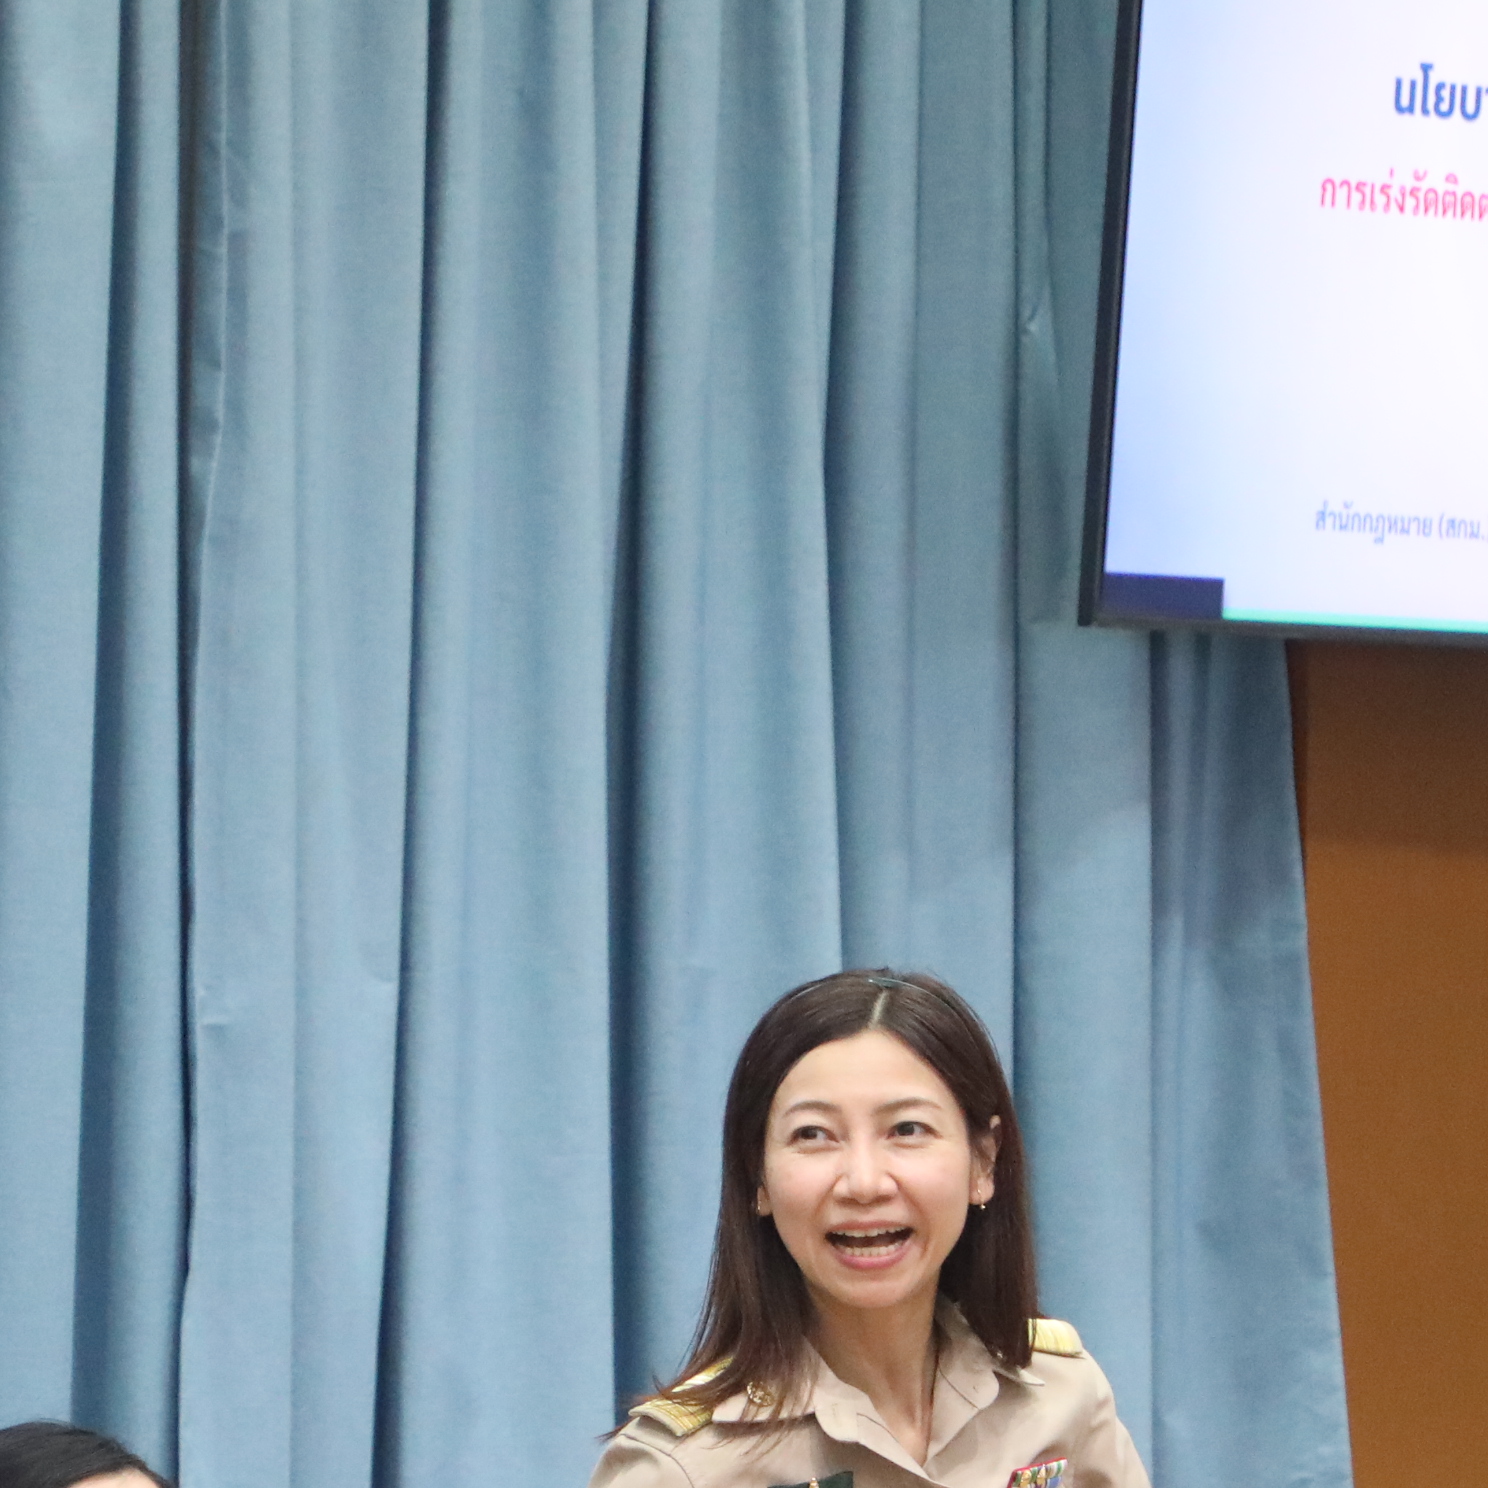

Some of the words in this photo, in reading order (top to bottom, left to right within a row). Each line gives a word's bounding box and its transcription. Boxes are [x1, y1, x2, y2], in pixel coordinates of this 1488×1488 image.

[1315, 500, 1432, 545] สำนักกฎหมาย
